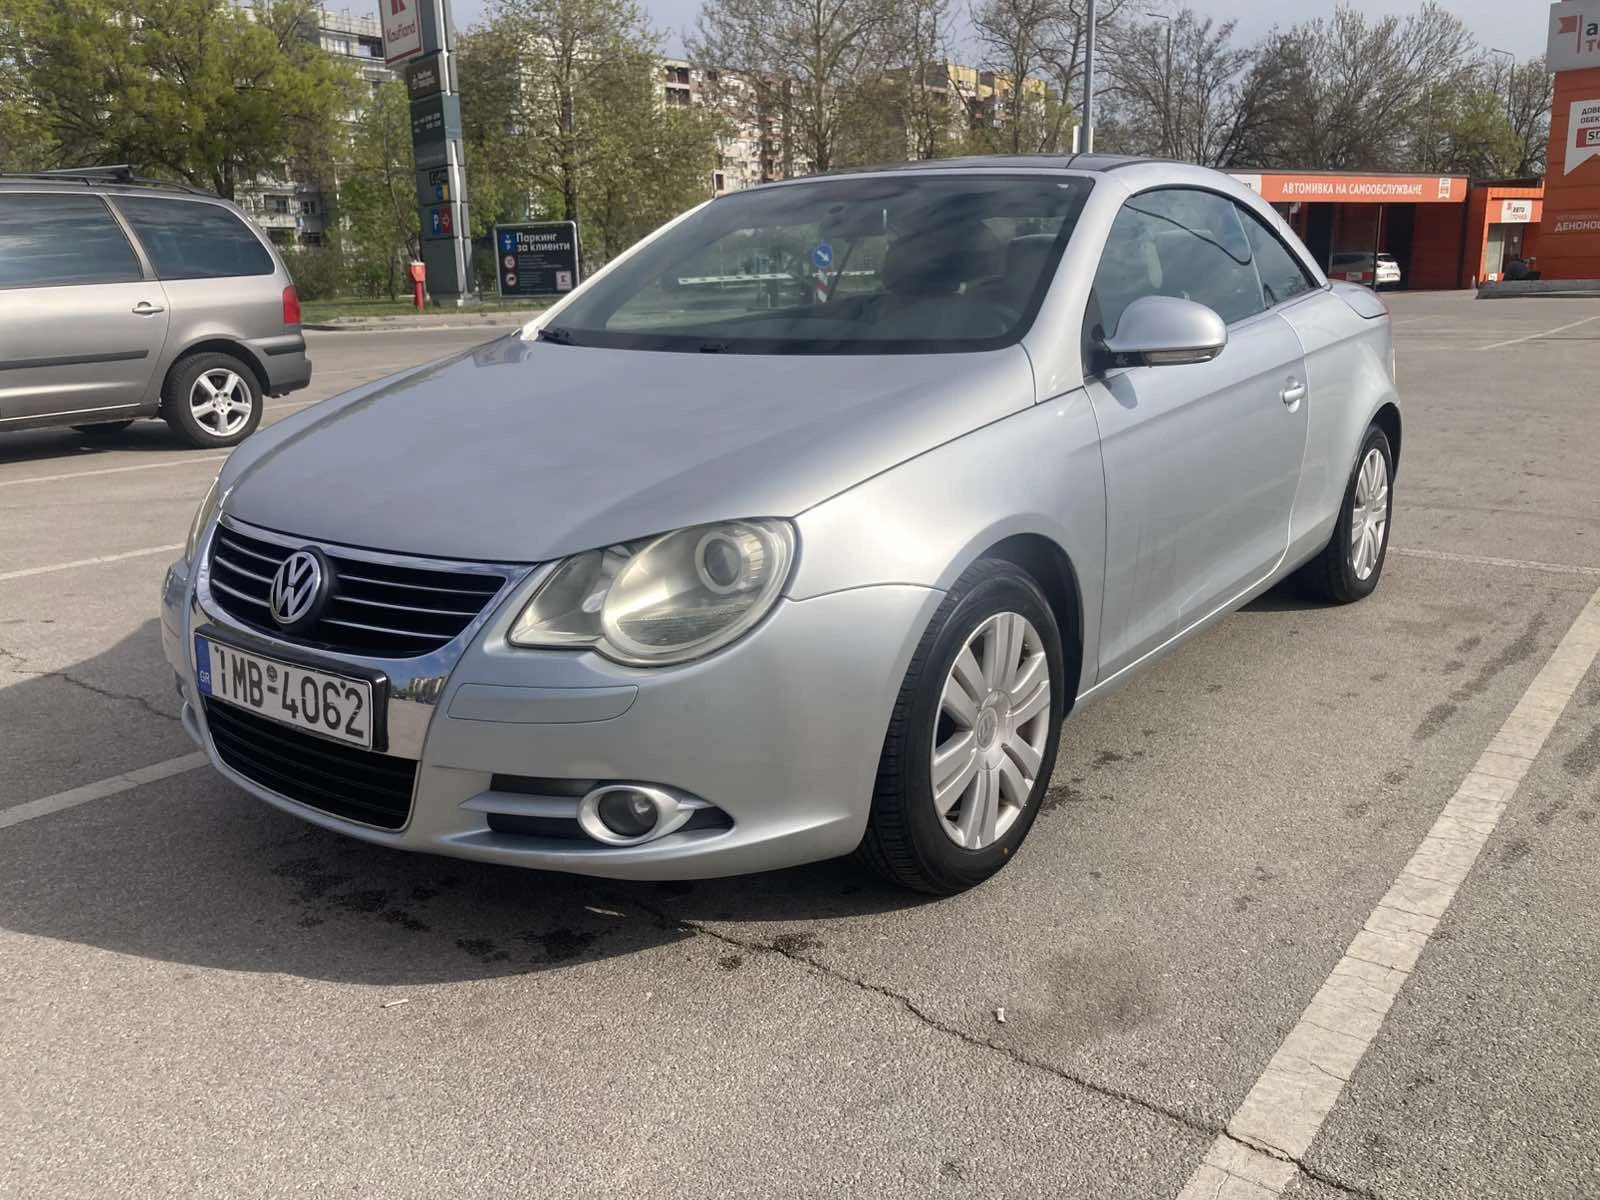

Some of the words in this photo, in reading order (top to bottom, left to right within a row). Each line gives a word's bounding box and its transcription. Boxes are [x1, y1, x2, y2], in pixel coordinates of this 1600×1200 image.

[1282, 182, 1334, 194] АВТОМИВКА
[1335, 182, 1347, 194] НА
[1349, 183, 1423, 194] САМООБСЛУЖВАНЕ
[516, 232, 558, 244] Паркинг
[517, 244, 528, 252] за
[530, 243, 571, 252] клиенти
[199, 671, 210, 683] GR
